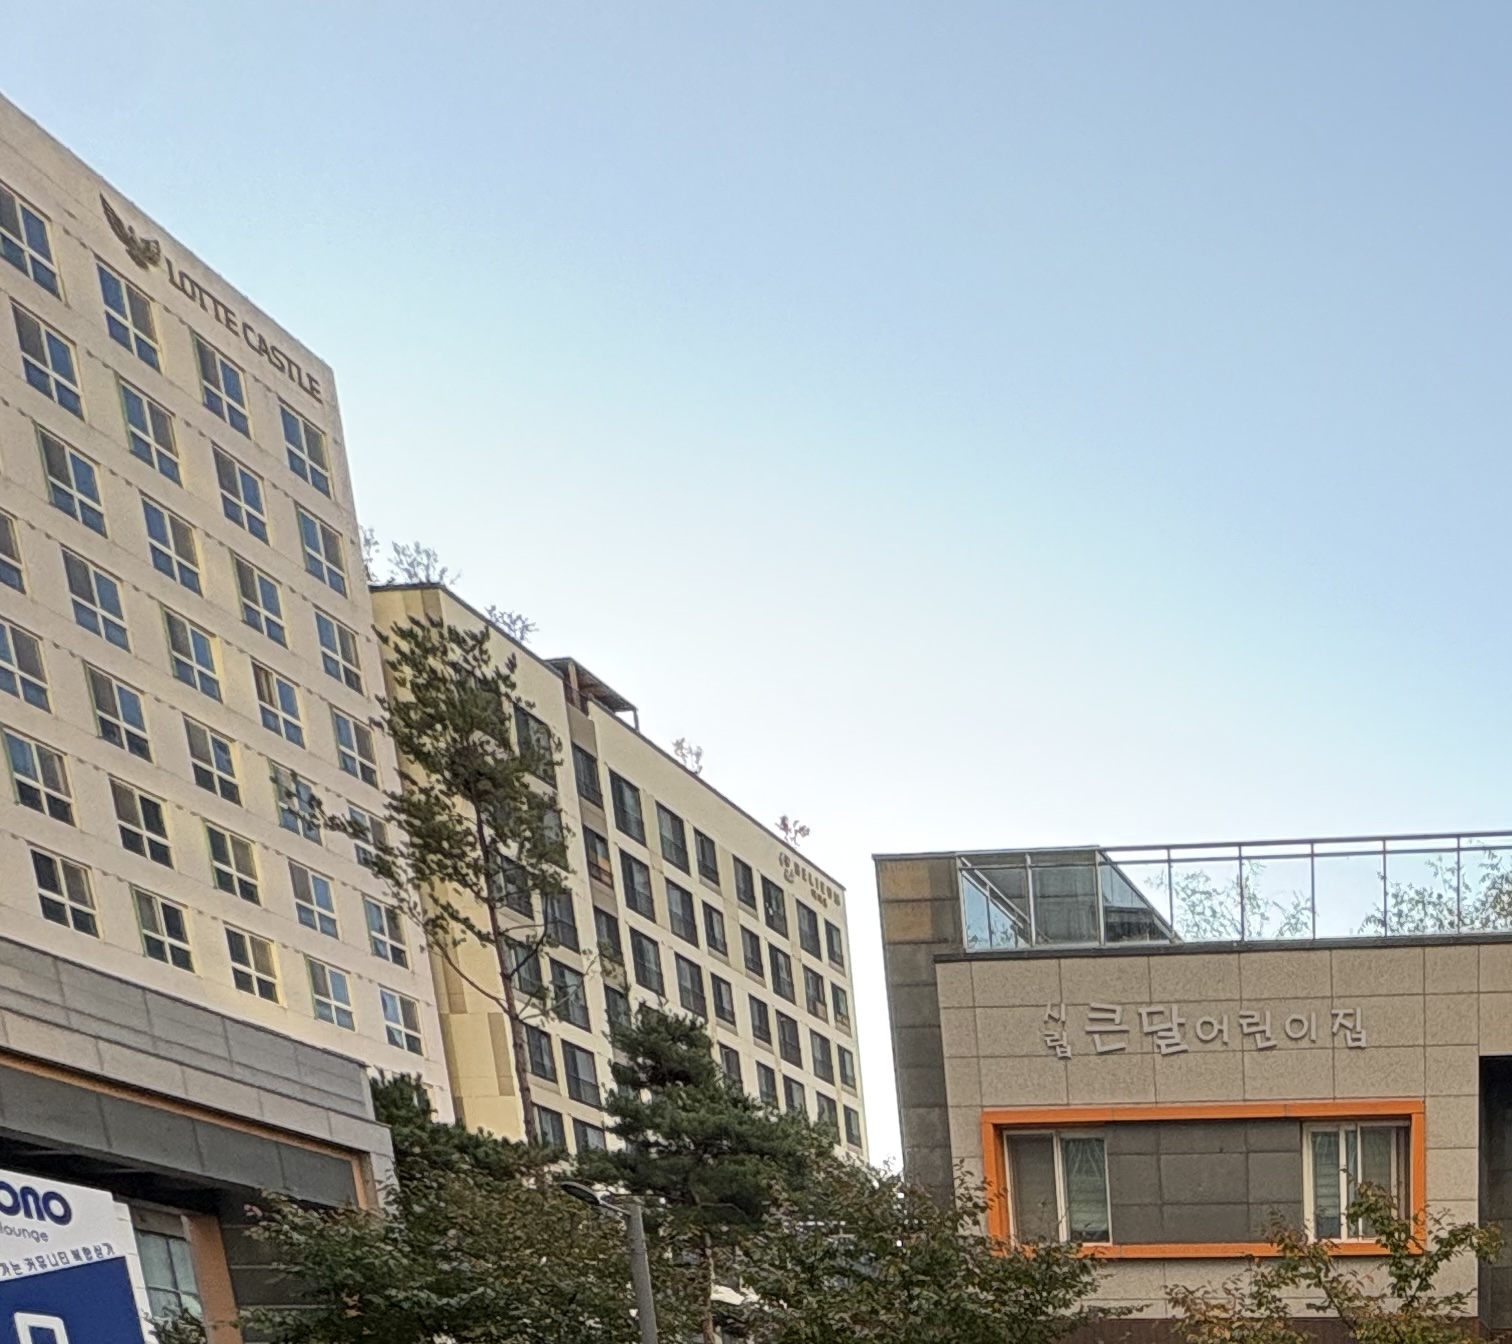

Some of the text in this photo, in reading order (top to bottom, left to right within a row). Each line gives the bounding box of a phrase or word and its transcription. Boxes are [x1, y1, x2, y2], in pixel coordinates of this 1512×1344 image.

[164, 254, 323, 405] LOTTE CASTLE
[1043, 1001, 1367, 1060] 시립 큰달어린이집
